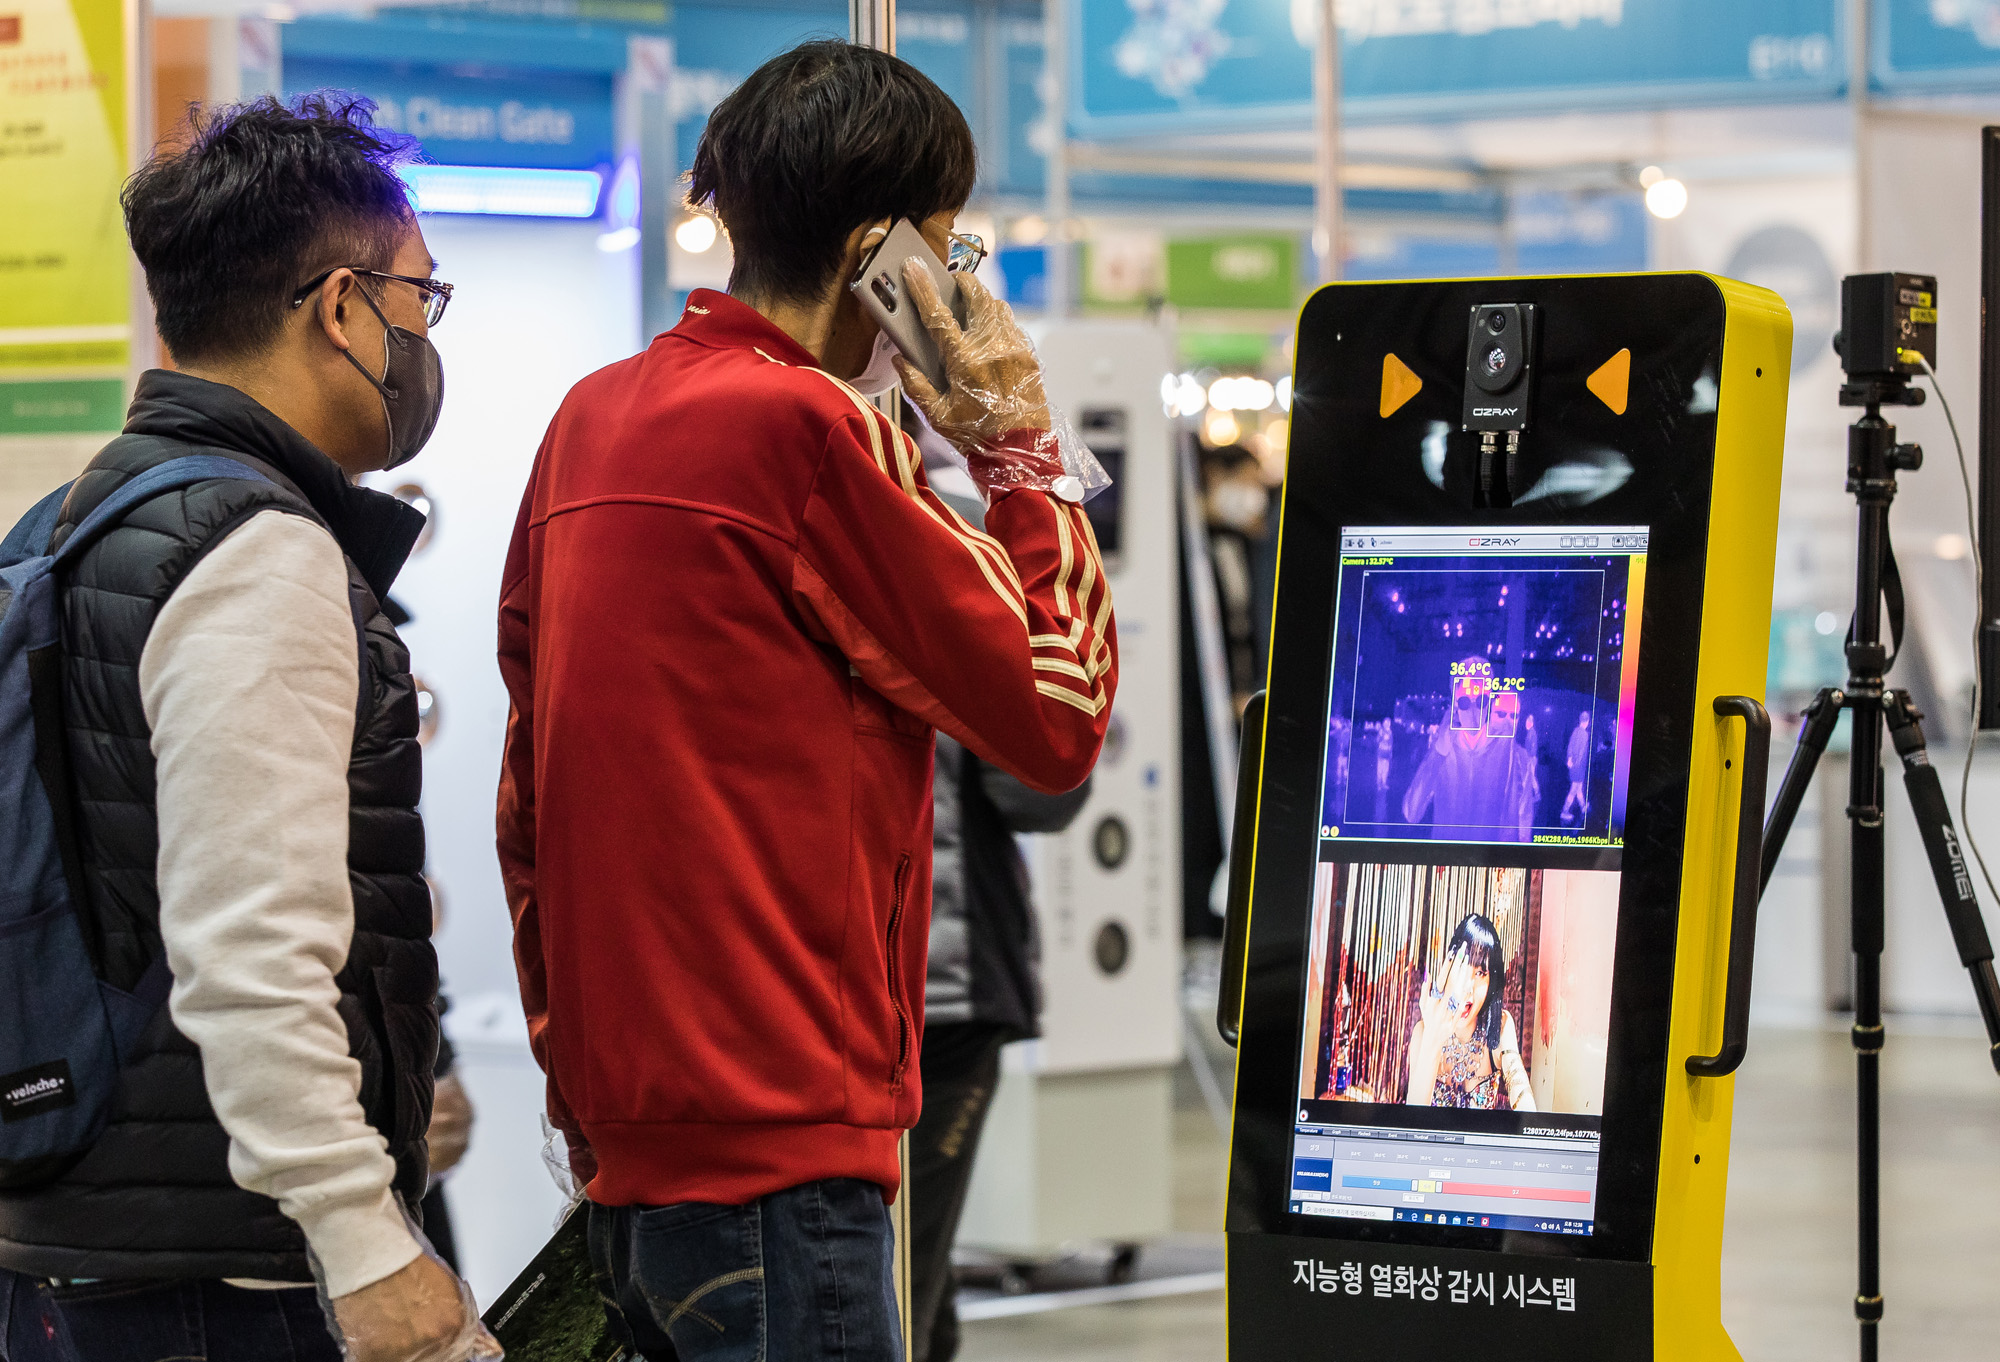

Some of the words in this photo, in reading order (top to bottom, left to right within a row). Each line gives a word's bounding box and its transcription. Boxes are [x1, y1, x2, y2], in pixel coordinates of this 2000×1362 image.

[1342, 557, 1365, 566] Camera
[1449, 661, 1491, 676] 36.4°C
[1484, 677, 1526, 691] 36.2°C
[1293, 1259, 1363, 1296] 지능형
[1369, 1264, 1443, 1301] 열화상
[1447, 1270, 1495, 1306] 감시
[1502, 1274, 1576, 1312] 시스템
